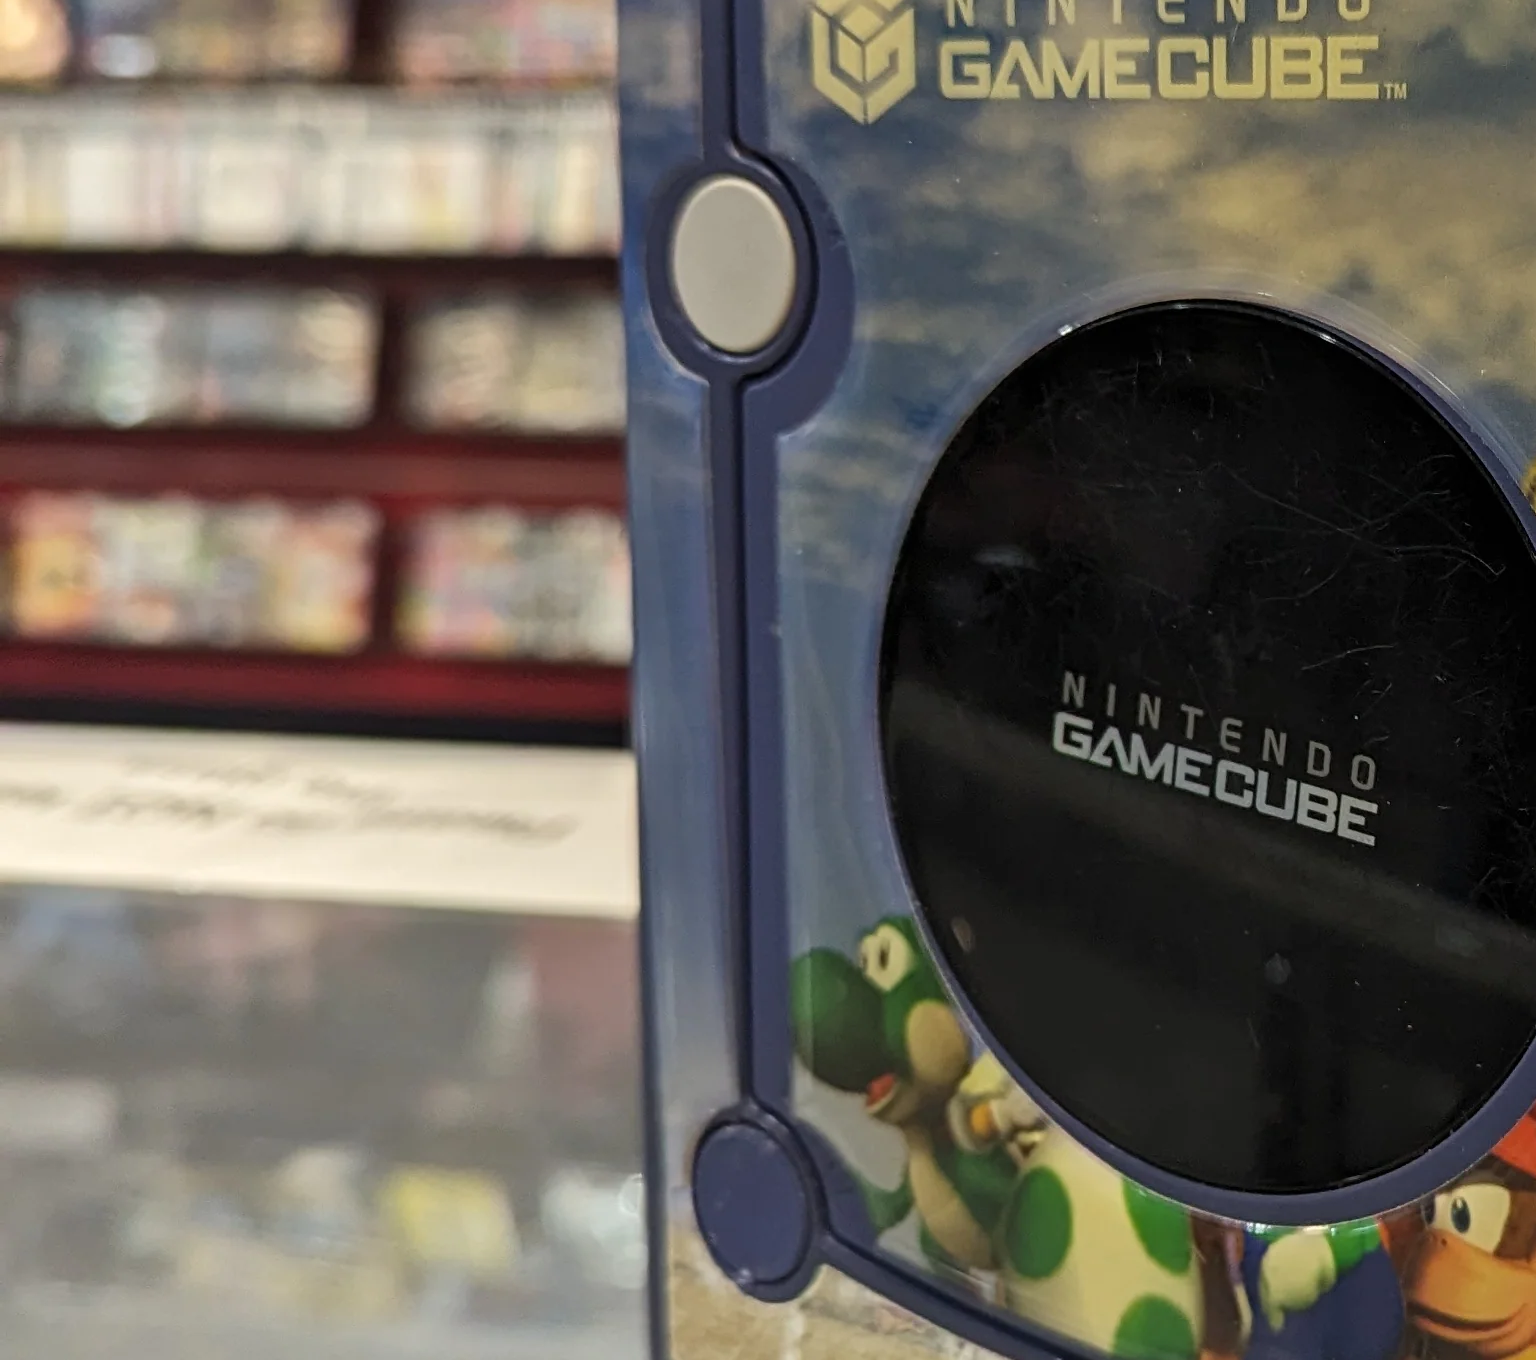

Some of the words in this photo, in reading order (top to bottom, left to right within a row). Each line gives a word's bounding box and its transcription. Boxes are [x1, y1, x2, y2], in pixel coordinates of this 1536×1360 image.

[939, 36, 1379, 100] GAMECUBE
[1053, 712, 1378, 846] GAMECUBE
[1062, 671, 1376, 790] NINTENDO
